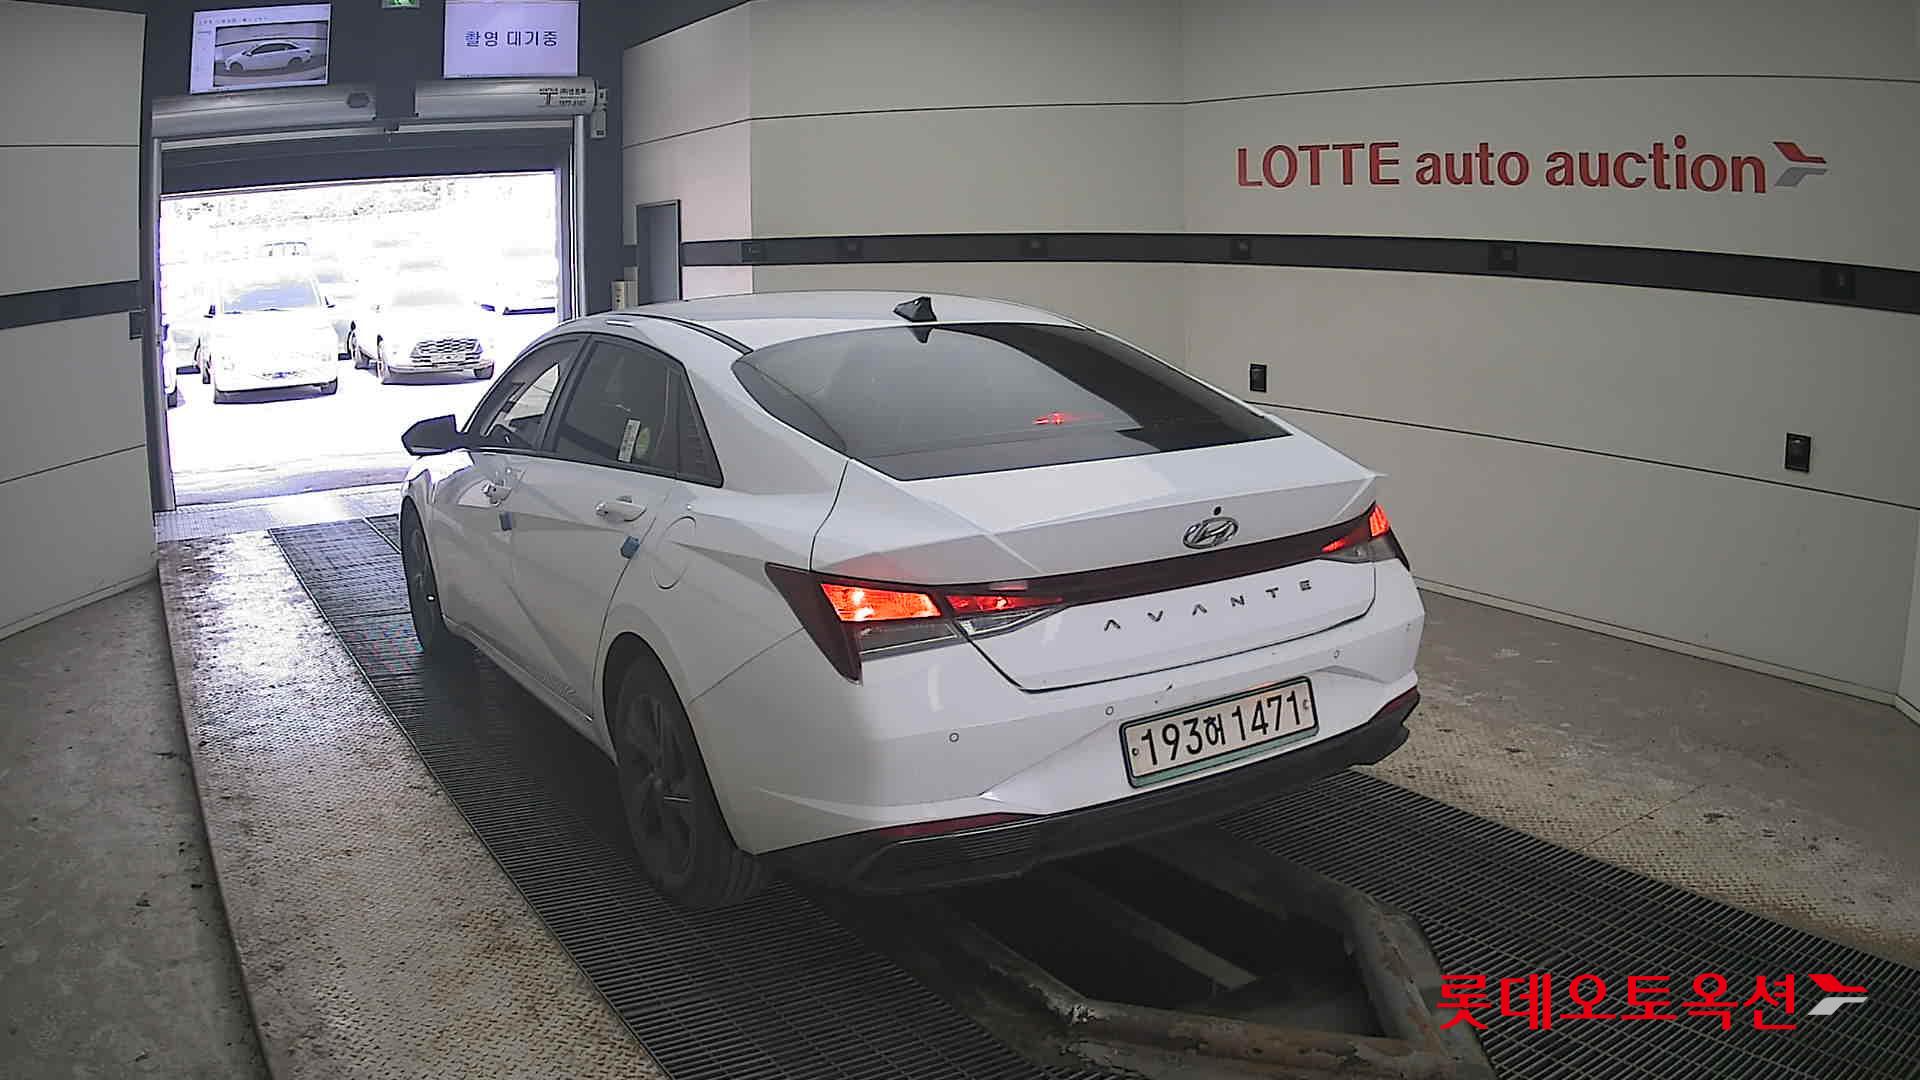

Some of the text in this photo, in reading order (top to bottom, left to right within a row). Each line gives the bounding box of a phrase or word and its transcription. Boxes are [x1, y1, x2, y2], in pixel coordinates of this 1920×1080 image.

[464, 31, 557, 47] 촬영 대기중
[1237, 134, 1767, 194] LOTTE auto auction
[1104, 579, 1312, 632] AVANTE
[1140, 690, 1301, 766] 193허 1471
